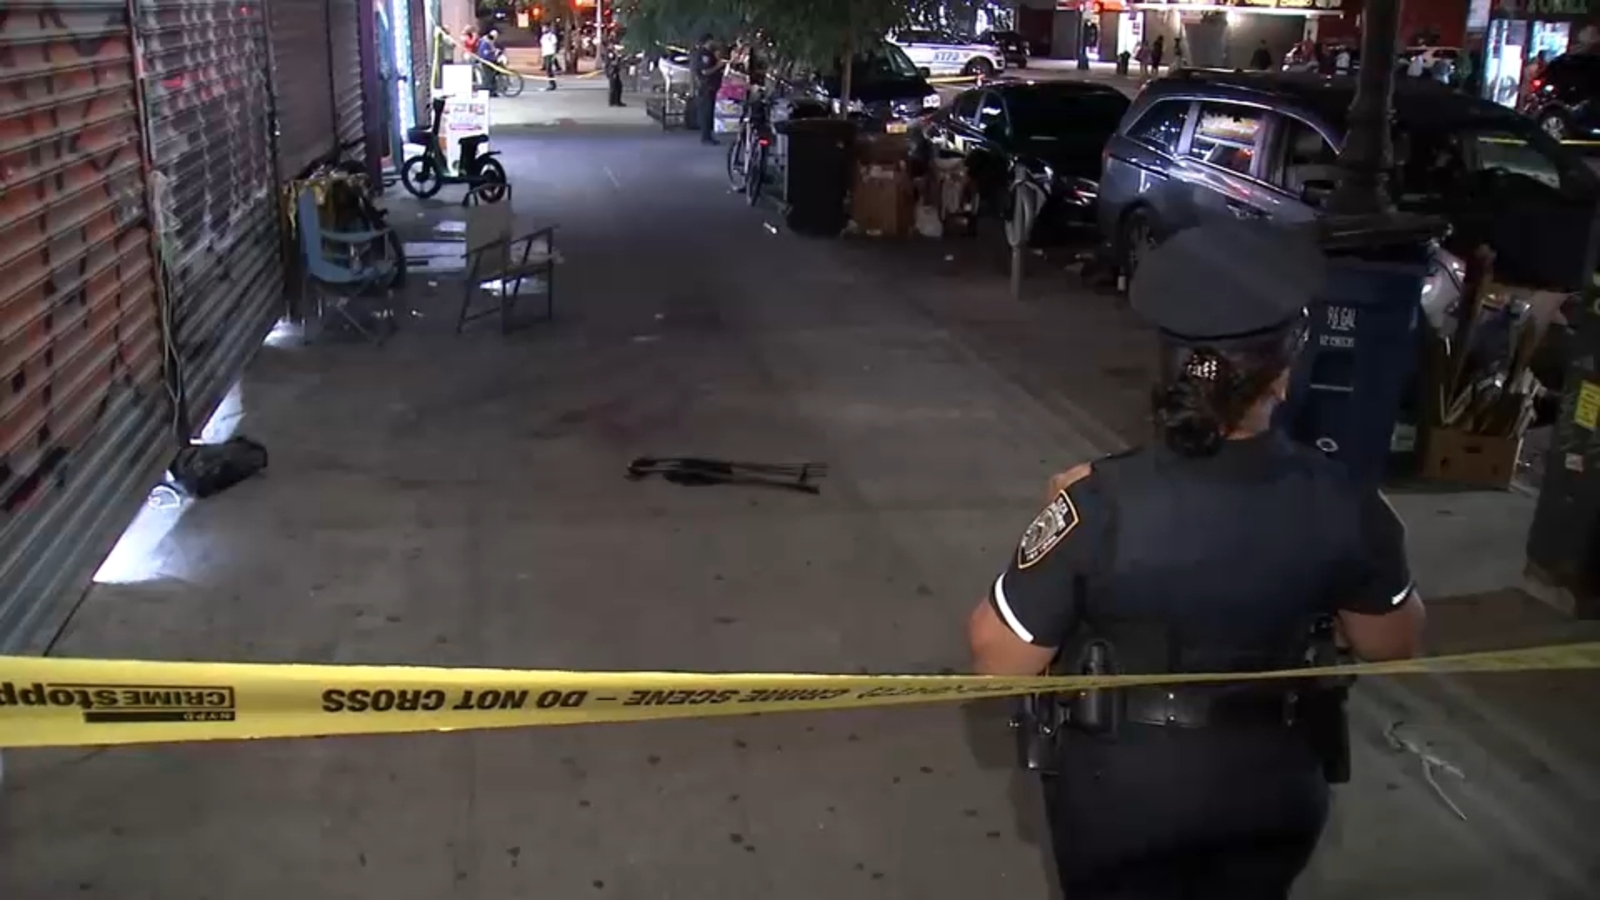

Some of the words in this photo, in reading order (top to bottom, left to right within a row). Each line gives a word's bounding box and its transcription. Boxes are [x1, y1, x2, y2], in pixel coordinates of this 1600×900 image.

[321, 688, 446, 713] CROSS
[452, 689, 529, 711] NOT
[535, 690, 588, 708] DO
[623, 689, 740, 706] SCENE
[738, 687, 851, 704] CRIME
[183, 712, 232, 721] NYPD
